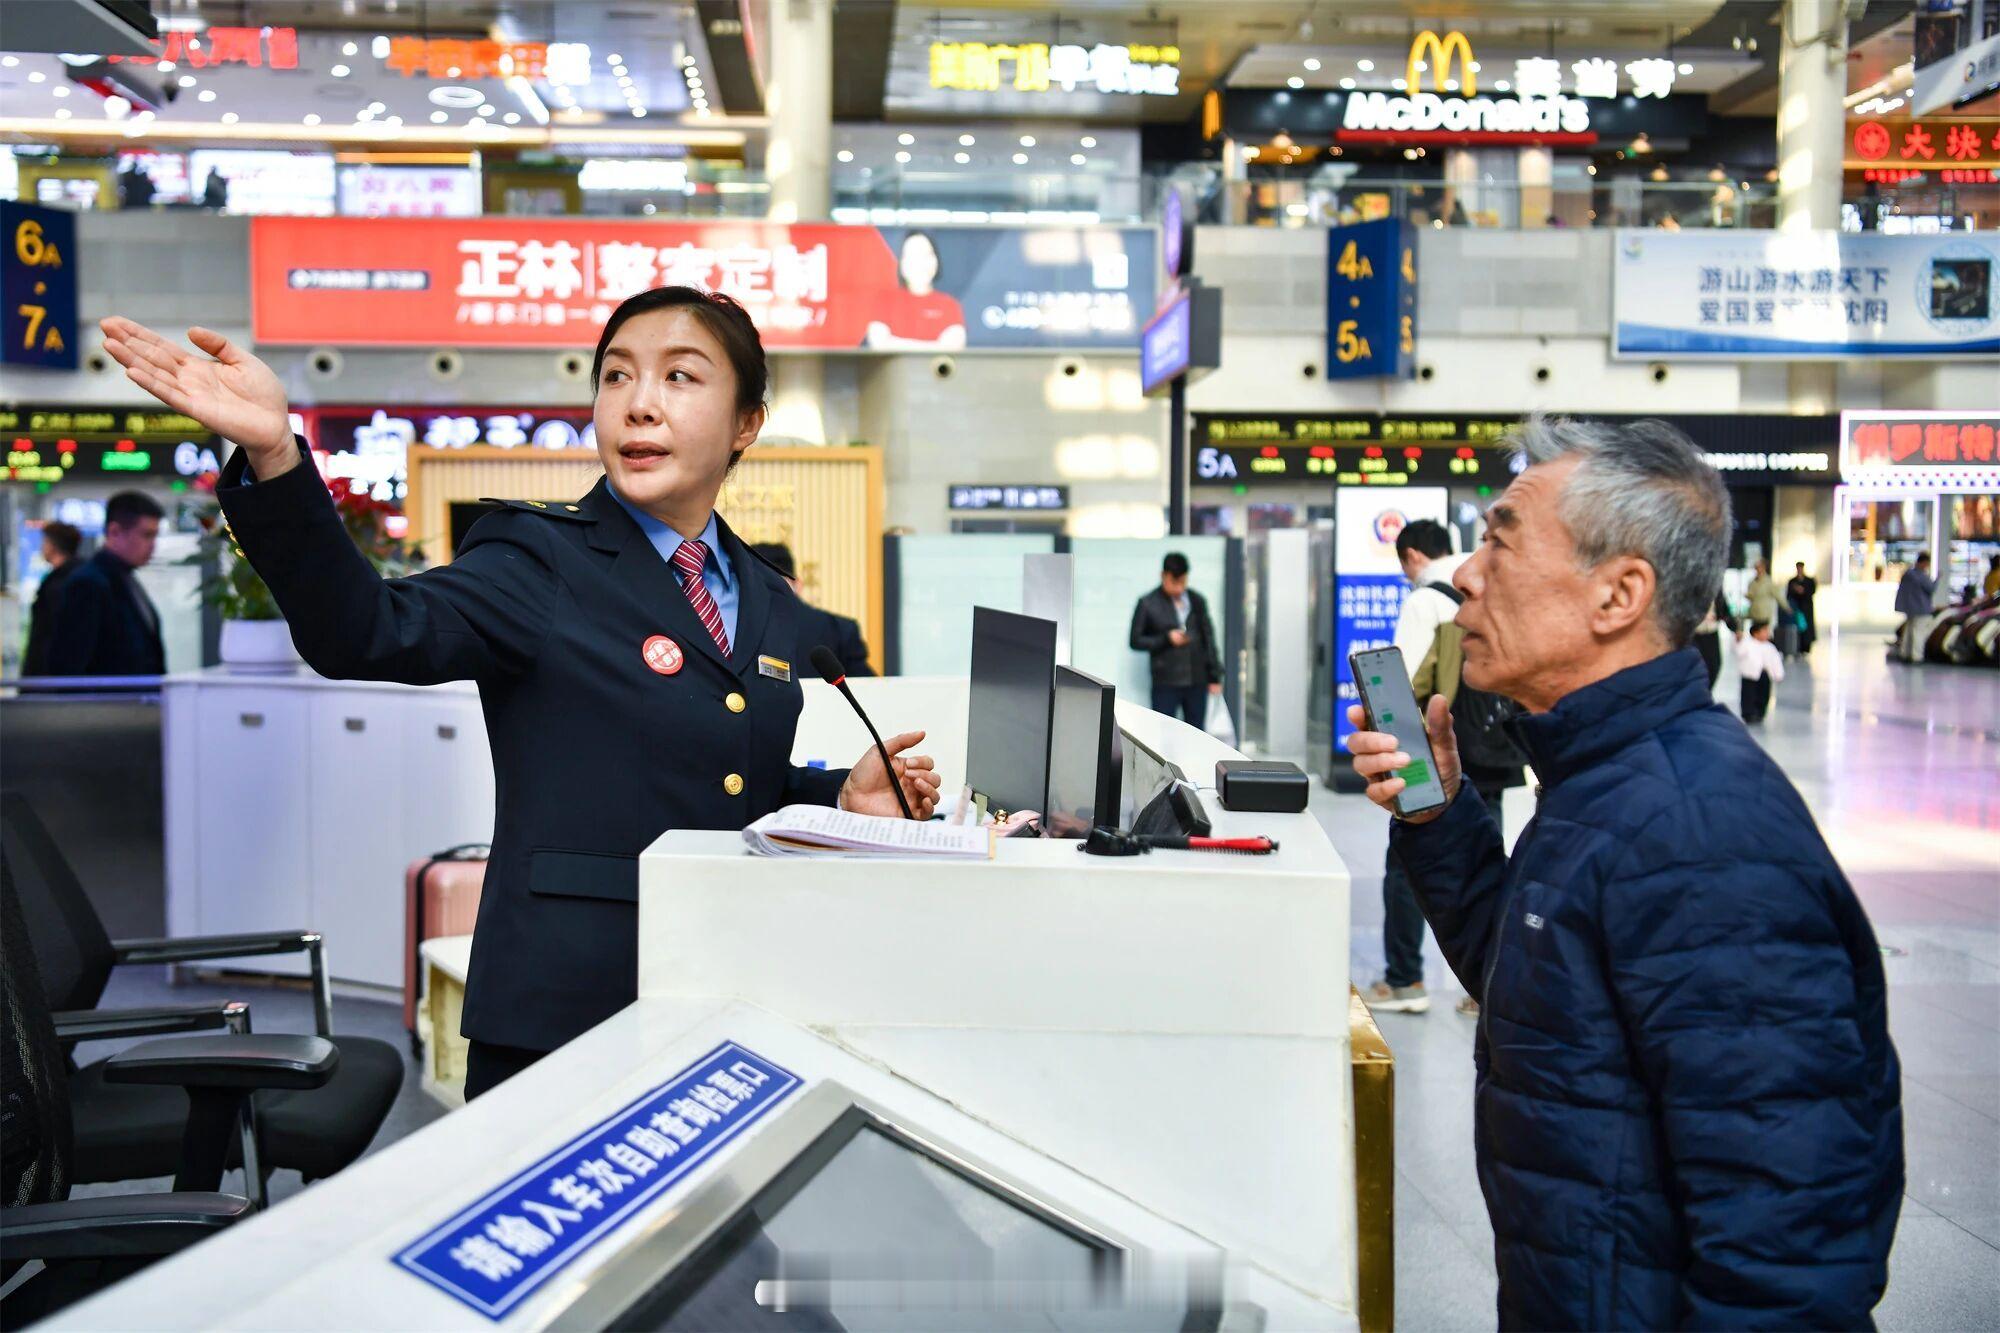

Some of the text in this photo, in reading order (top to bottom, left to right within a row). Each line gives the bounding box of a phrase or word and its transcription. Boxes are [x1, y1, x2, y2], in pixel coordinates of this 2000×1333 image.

[1343, 91, 1590, 132] McDonald's
[1901, 124, 2000, 161] 大块
[15, 219, 63, 269] 6A
[1336, 240, 1374, 281] 4A
[457, 239, 582, 299] 正林
[1700, 266, 1889, 293] 游山游水游天下
[18, 304, 64, 353] 7A
[1700, 299, 1888, 325] 爱国爱沈阳
[1336, 319, 1373, 363] 5A
[1198, 447, 1238, 479] 5A
[449, 1060, 771, 1282] 请输入车次自助查询检票口
